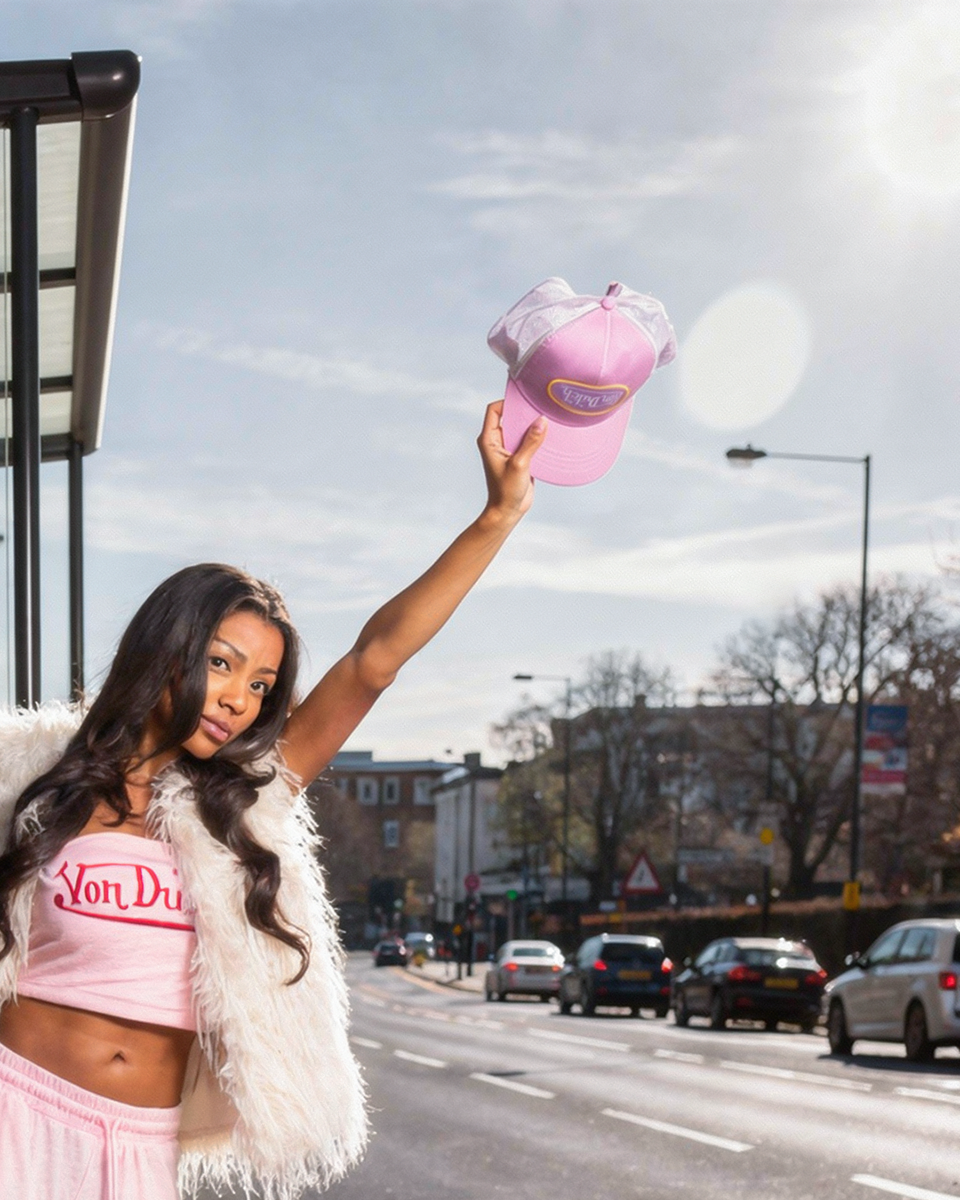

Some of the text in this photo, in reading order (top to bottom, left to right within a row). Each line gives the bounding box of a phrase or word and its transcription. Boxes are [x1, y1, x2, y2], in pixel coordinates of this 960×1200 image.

[562, 387, 600, 407] Dutch
[54, 861, 182, 911] Von Du
